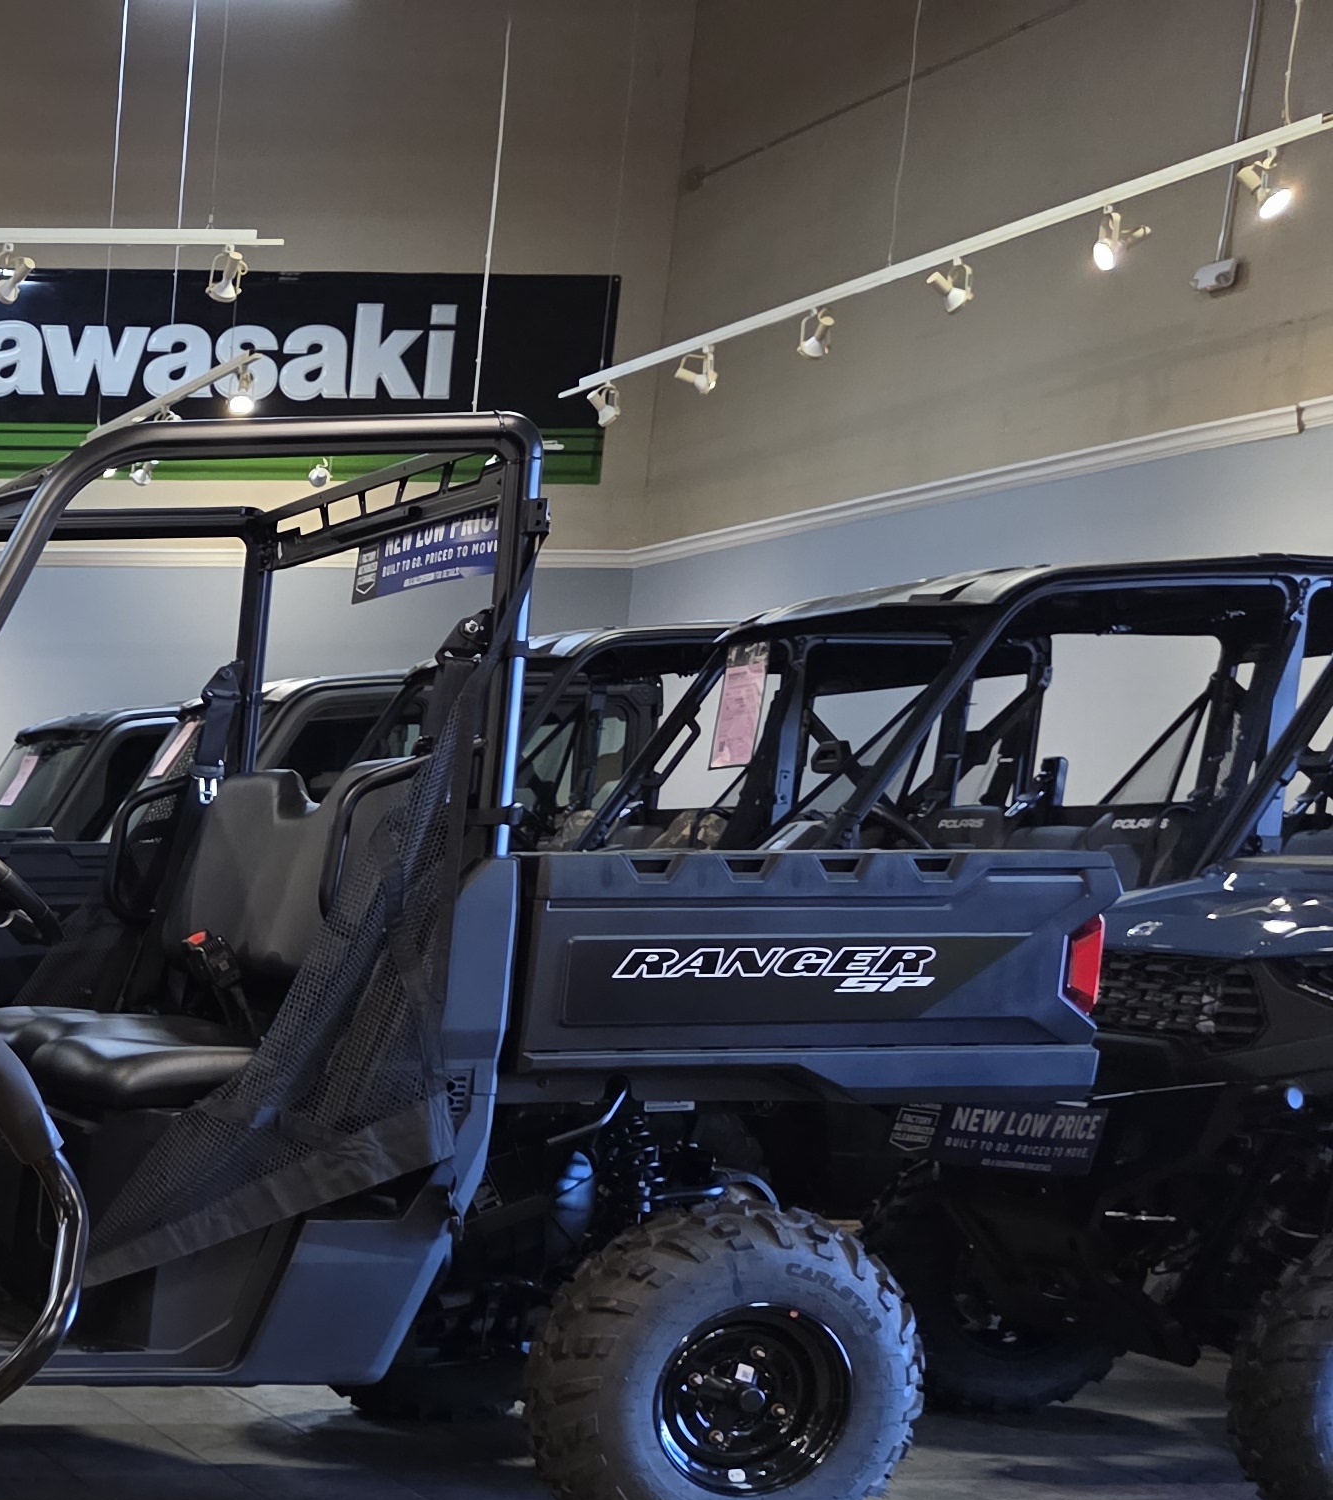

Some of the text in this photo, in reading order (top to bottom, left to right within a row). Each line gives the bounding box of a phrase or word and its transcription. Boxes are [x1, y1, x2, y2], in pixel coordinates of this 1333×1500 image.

[450, 510, 499, 539] PRIC
[402, 559, 410, 571] TO
[425, 548, 453, 565] PRICED
[457, 545, 468, 558] TO
[938, 818, 984, 829] POLARIS
[612, 946, 936, 978] RANGER
[834, 976, 935, 992] SP
[951, 1106, 1102, 1140] NEW LOW PRICE
[944, 1136, 977, 1149] BUILT
[980, 1140, 993, 1151] TO
